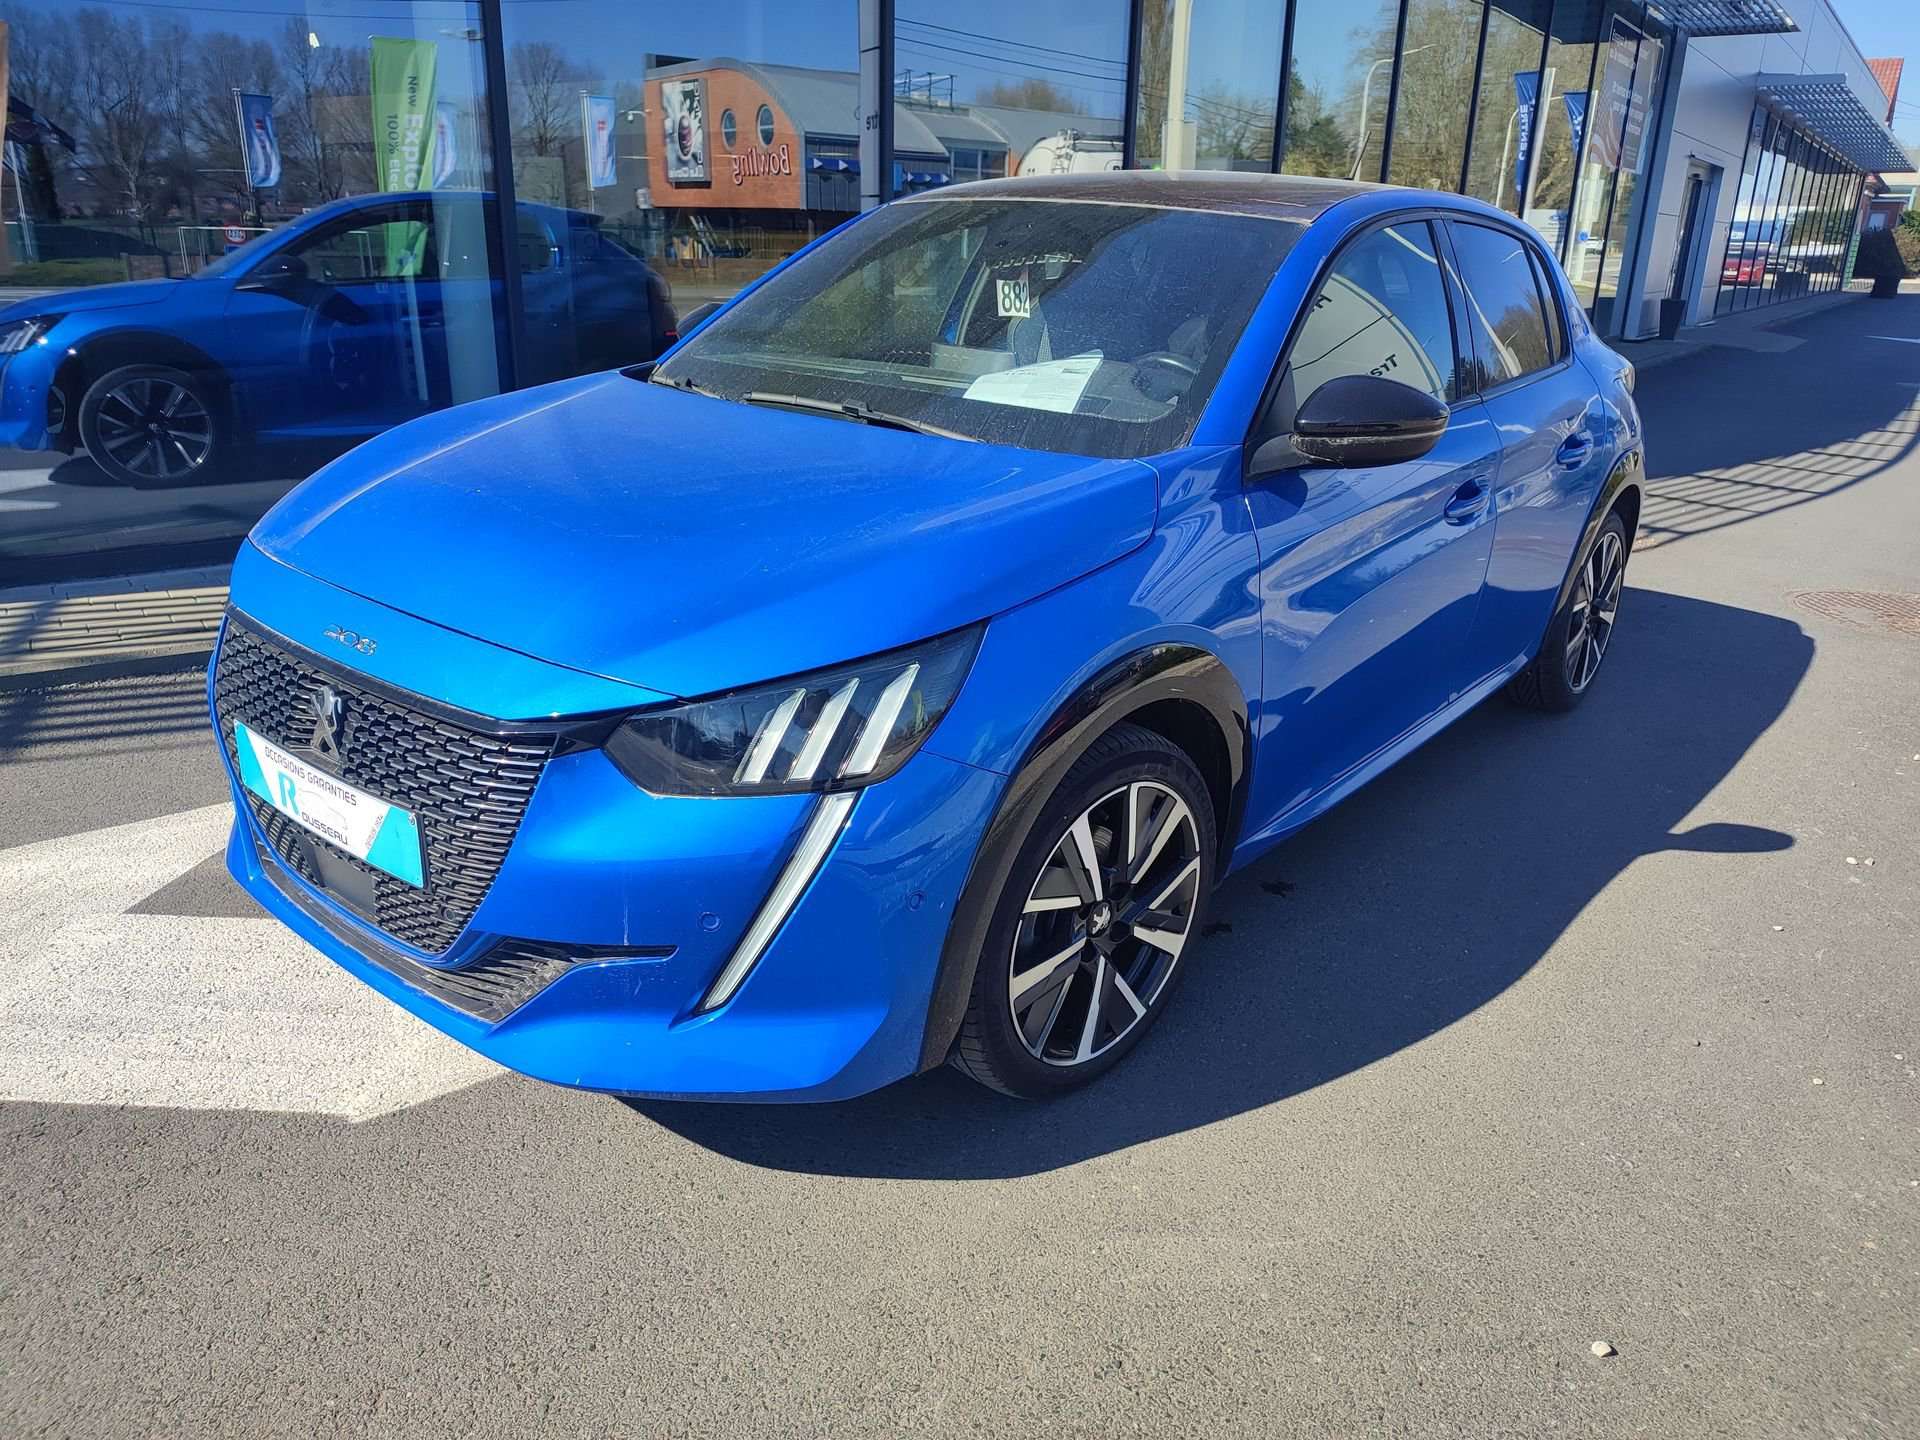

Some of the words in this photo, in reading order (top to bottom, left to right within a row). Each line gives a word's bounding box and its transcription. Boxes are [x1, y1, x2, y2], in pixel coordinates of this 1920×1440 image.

[408, 76, 419, 107] New
[387, 114, 400, 155] 100%
[1001, 281, 1029, 313] 882
[324, 624, 376, 656] 208
[264, 746, 306, 780] OCCASIONS
[307, 772, 357, 807] GARANTIES
